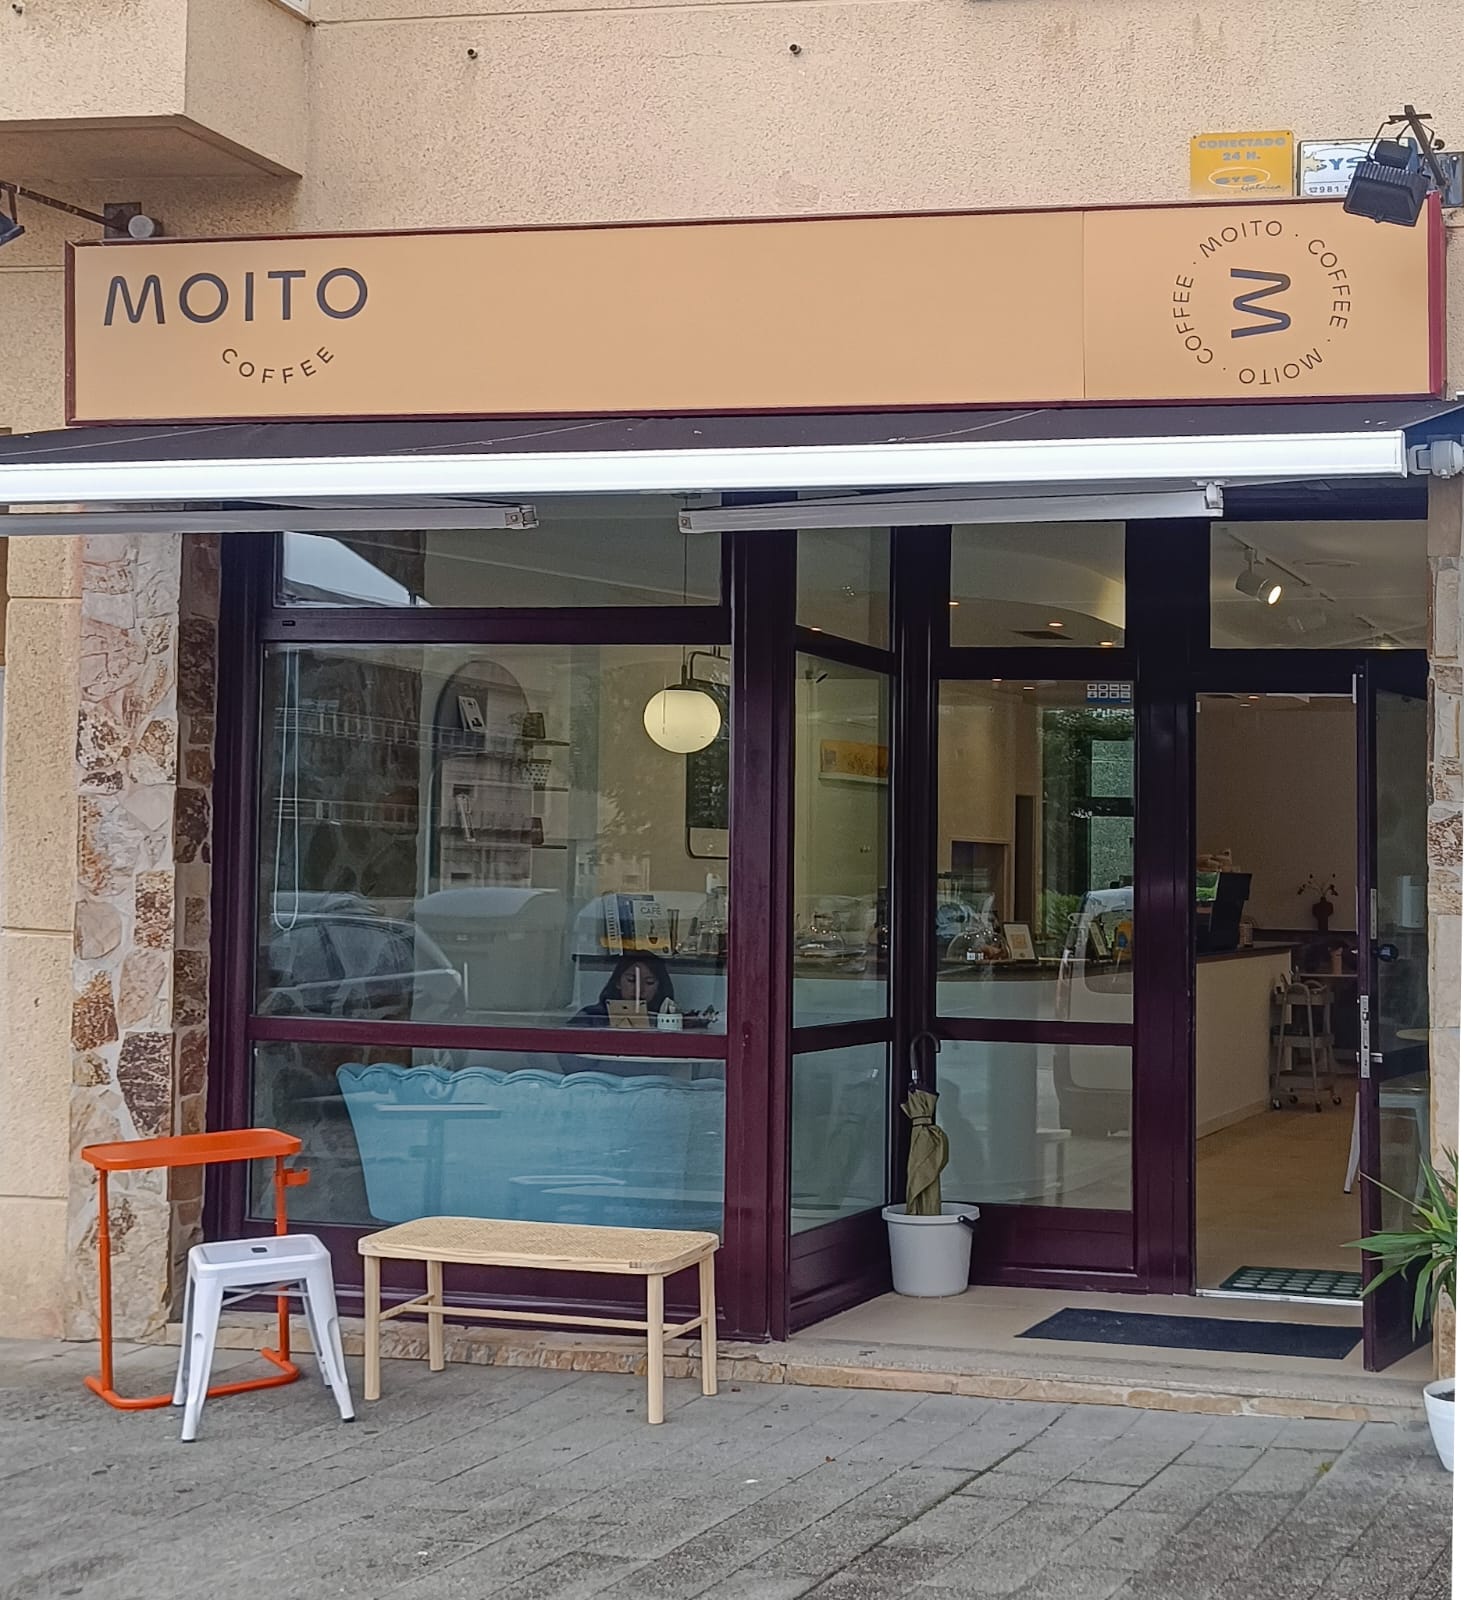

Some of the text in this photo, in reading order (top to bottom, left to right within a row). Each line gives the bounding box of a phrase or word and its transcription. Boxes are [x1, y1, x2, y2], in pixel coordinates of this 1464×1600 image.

[1198, 137, 1287, 149] CONECTADO
[1222, 151, 1241, 161] 24
[1199, 220, 1283, 258] MOITO
[103, 267, 368, 326] MOITO
[1308, 239, 1351, 330] COFFEE
[1172, 274, 1214, 365] COFFEE
[222, 346, 335, 385] COFFEE
[1238, 347, 1324, 385] MOITO
